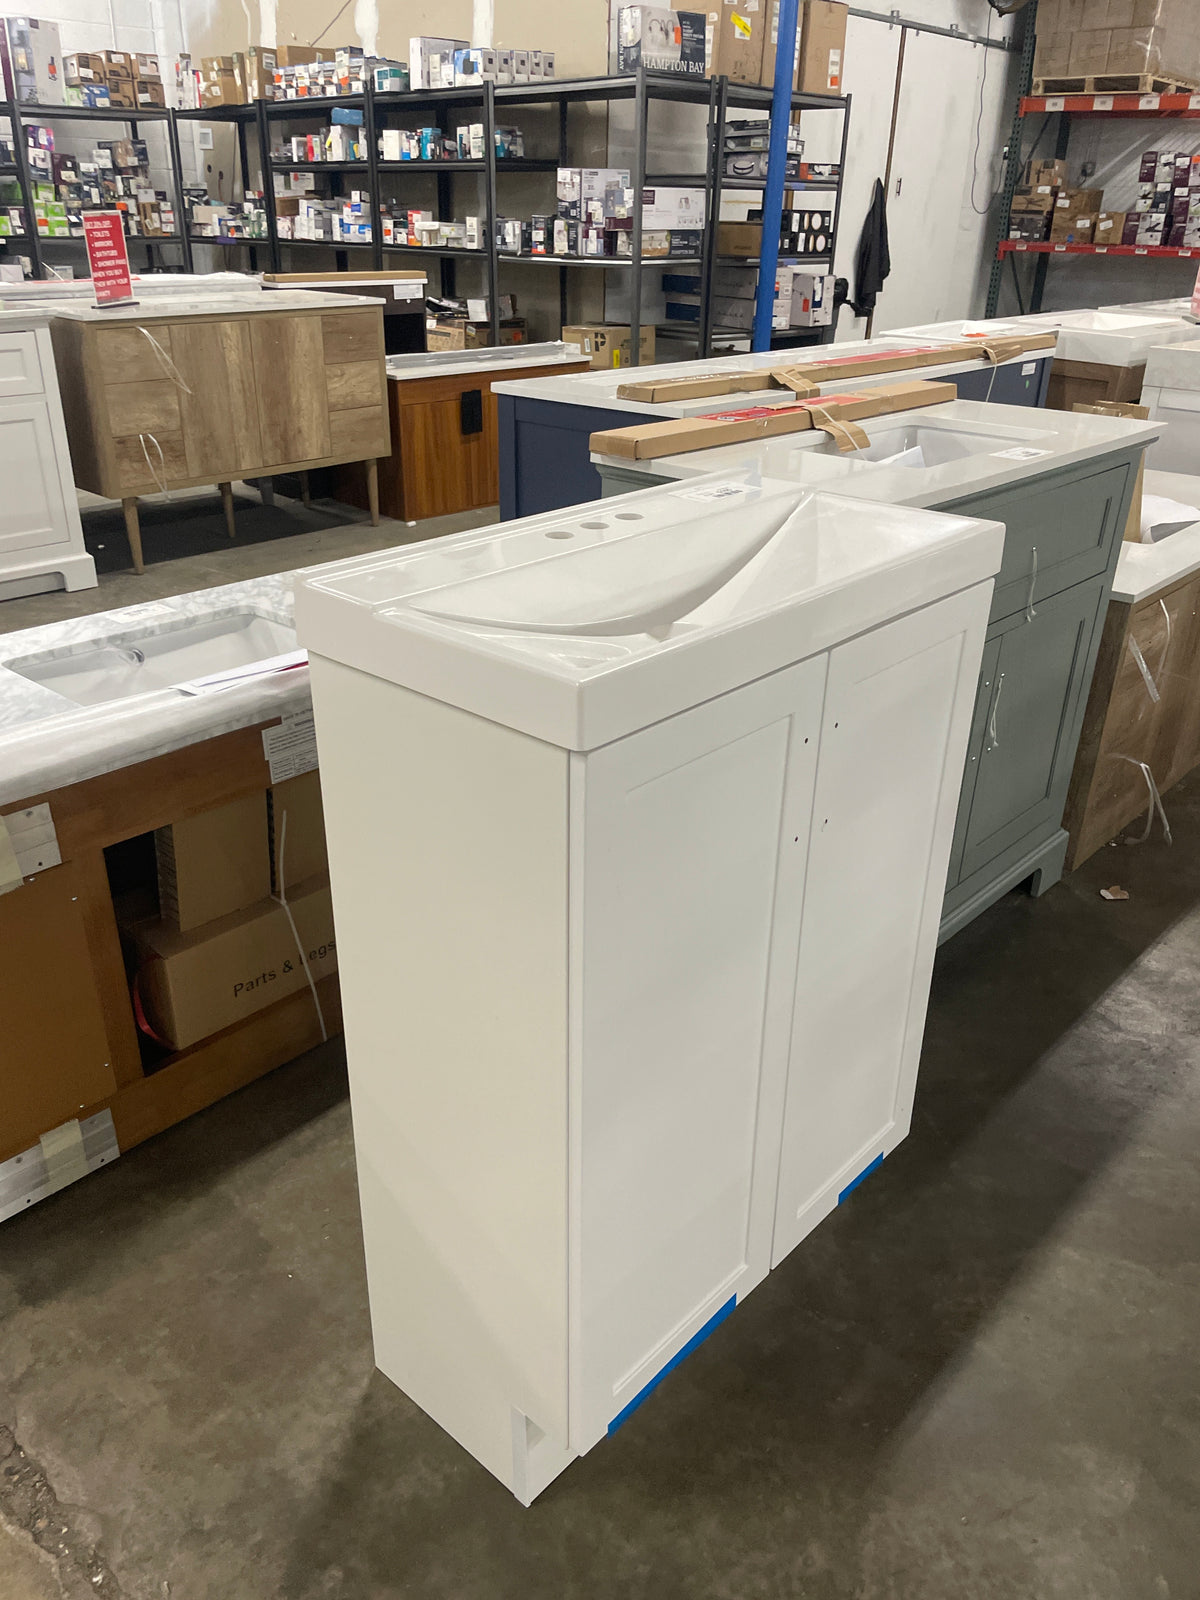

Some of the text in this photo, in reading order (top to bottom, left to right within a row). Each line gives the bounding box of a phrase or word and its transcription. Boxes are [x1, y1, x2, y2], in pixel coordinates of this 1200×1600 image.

[643, 57, 704, 73] HAMPTON BAY
[233, 970, 276, 998] Parts
[282, 960, 293, 973] &
